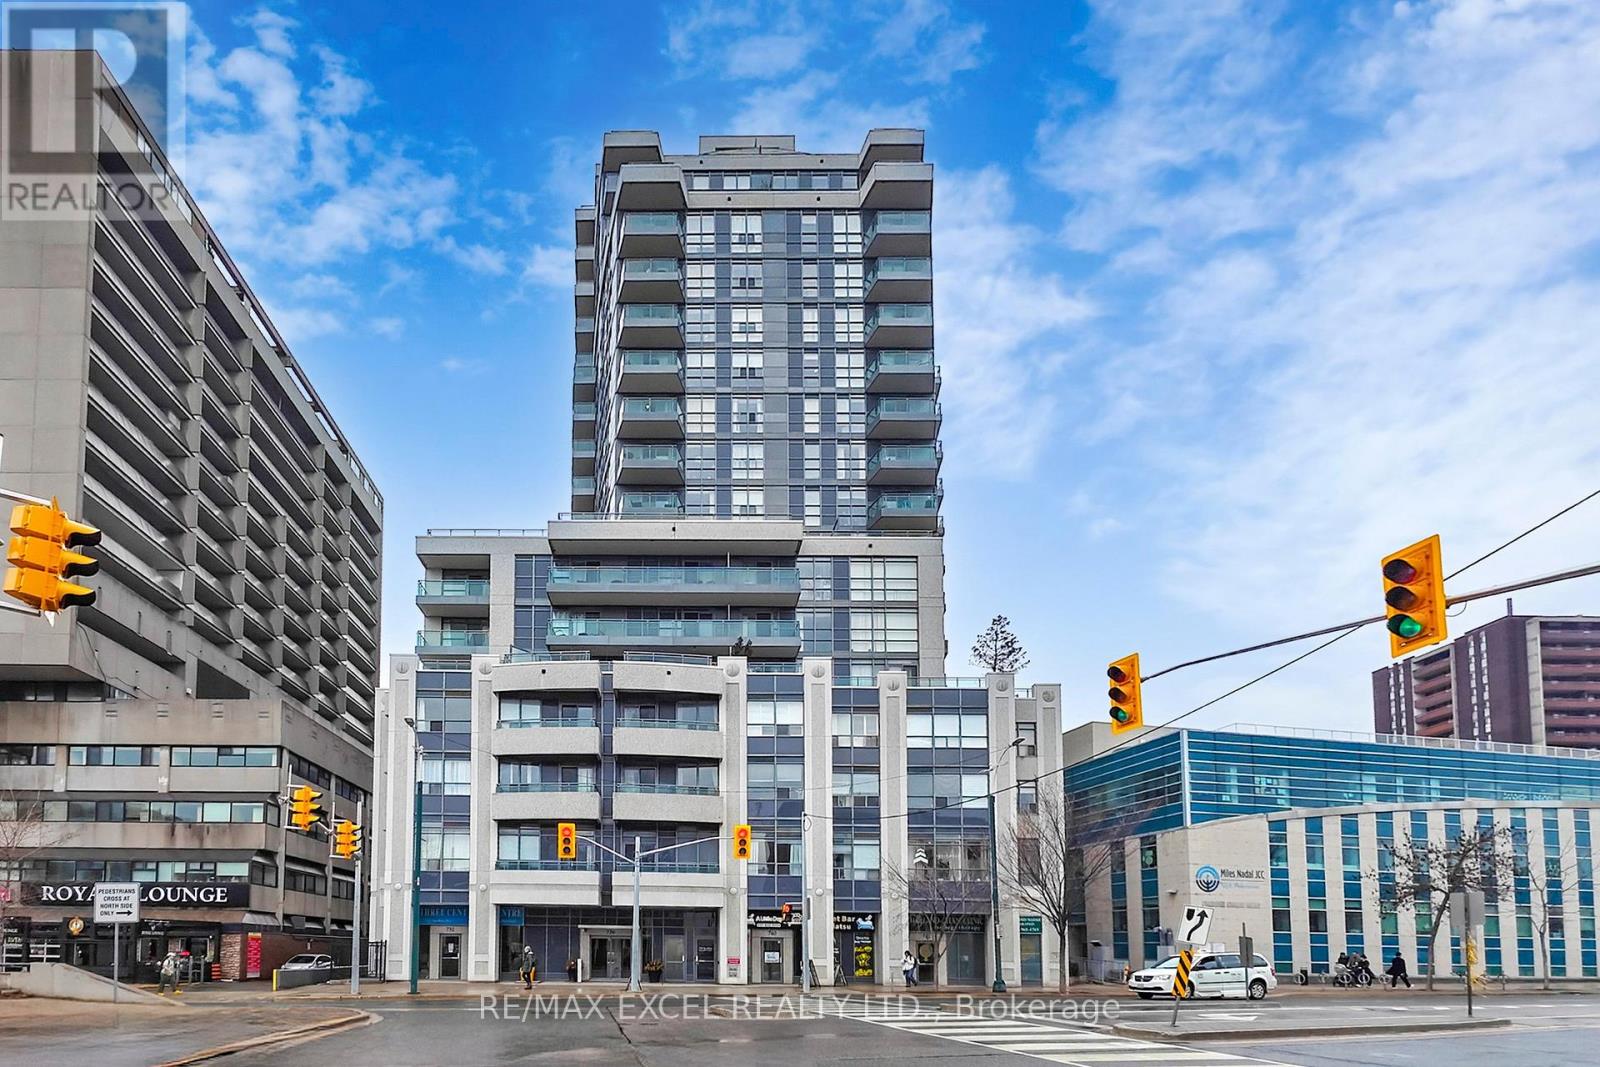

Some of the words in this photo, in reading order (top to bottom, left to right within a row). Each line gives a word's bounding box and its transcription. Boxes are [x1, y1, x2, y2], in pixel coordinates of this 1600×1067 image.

[1221, 869, 1235, 878] Miles
[1237, 870, 1253, 879] Nadal
[1255, 870, 1265, 879] JCC
[41, 886, 95, 901] ROYA
